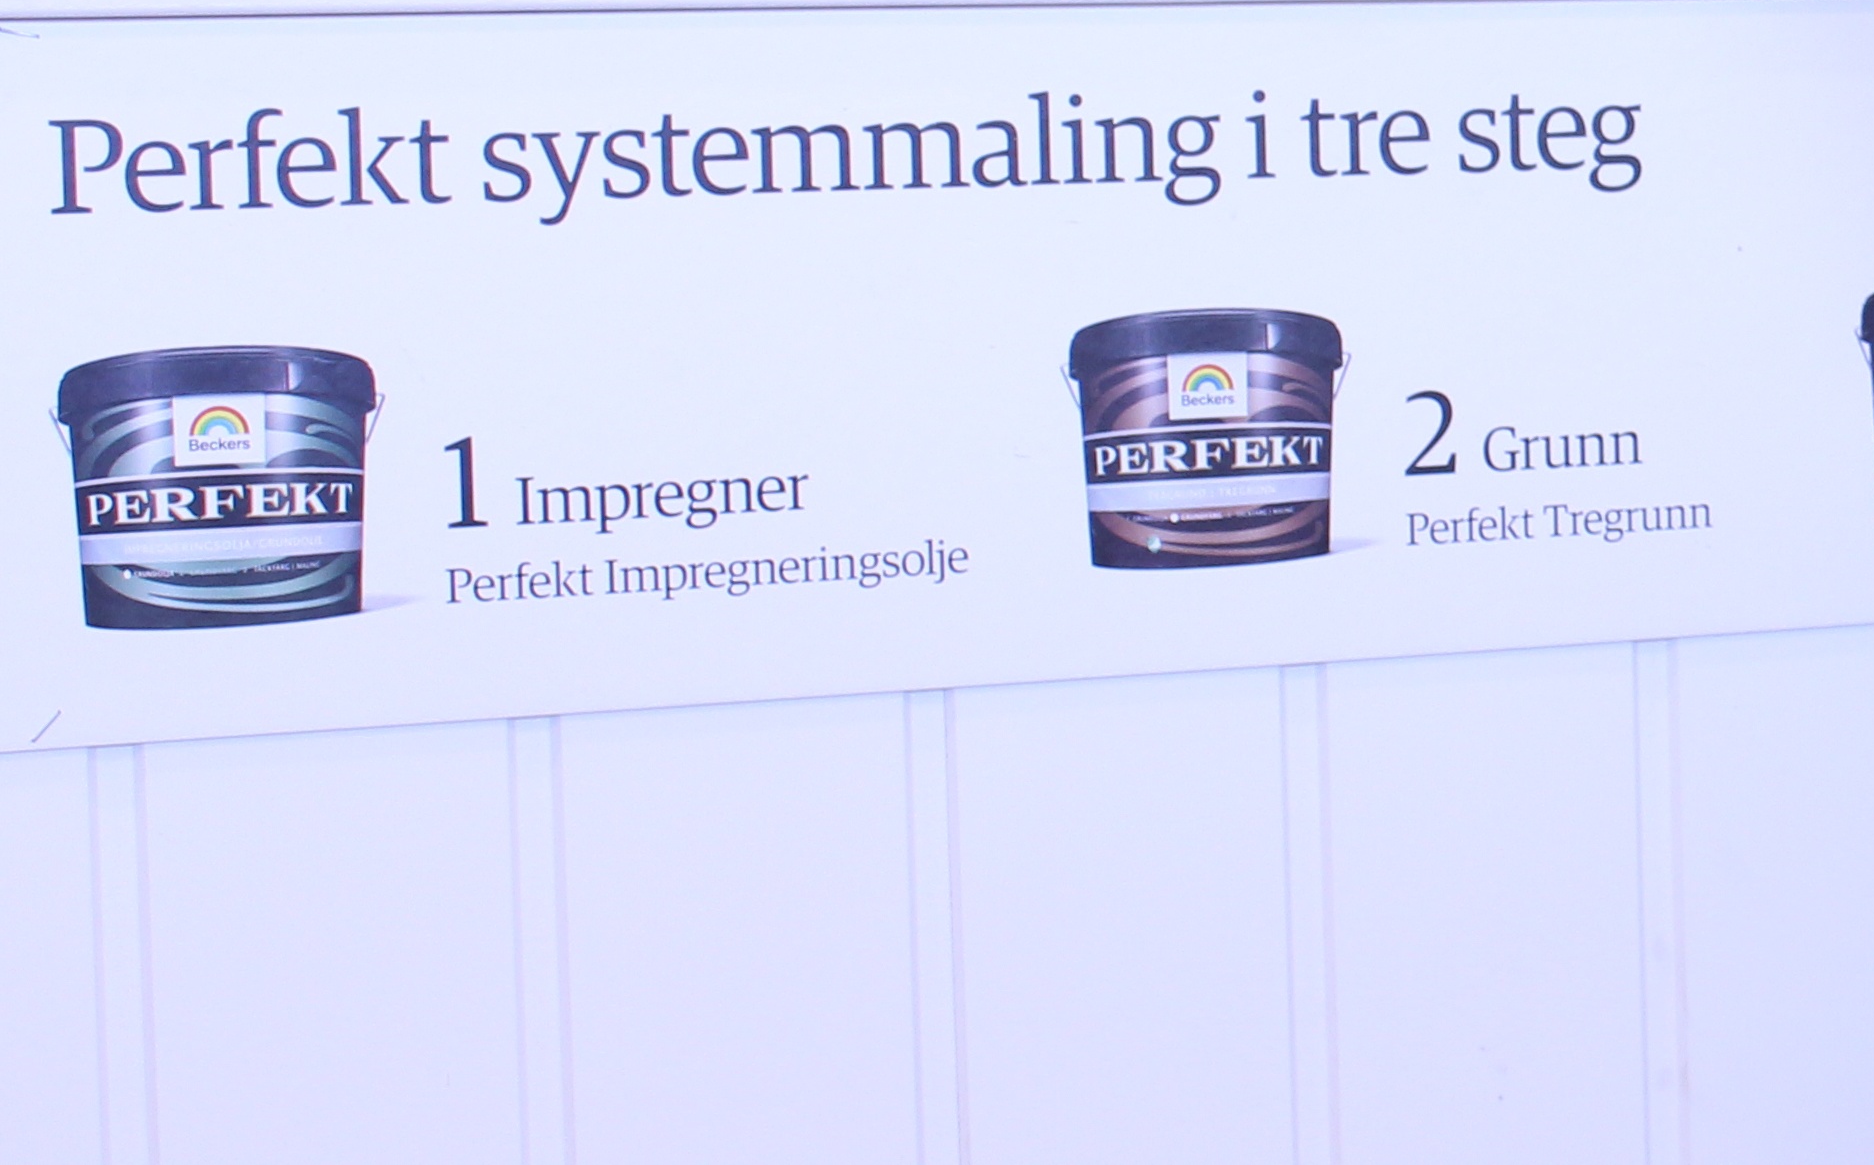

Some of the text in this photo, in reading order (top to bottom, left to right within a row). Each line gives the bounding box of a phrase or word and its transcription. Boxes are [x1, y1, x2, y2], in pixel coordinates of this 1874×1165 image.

[48, 89, 1643, 227] Perfekt systemmaling i tre steg
[1180, 392, 1236, 408] Beckers
[188, 436, 251, 453] Beckers
[1403, 389, 1643, 477] 2 Grunn
[1094, 435, 1323, 477] PERFEKT
[86, 482, 353, 526] PERFEKT
[444, 435, 810, 535] 1 Impregner
[1406, 503, 1713, 547] Perfekt Tregrunn
[446, 538, 969, 604] Perfekt Impregneringsolje
